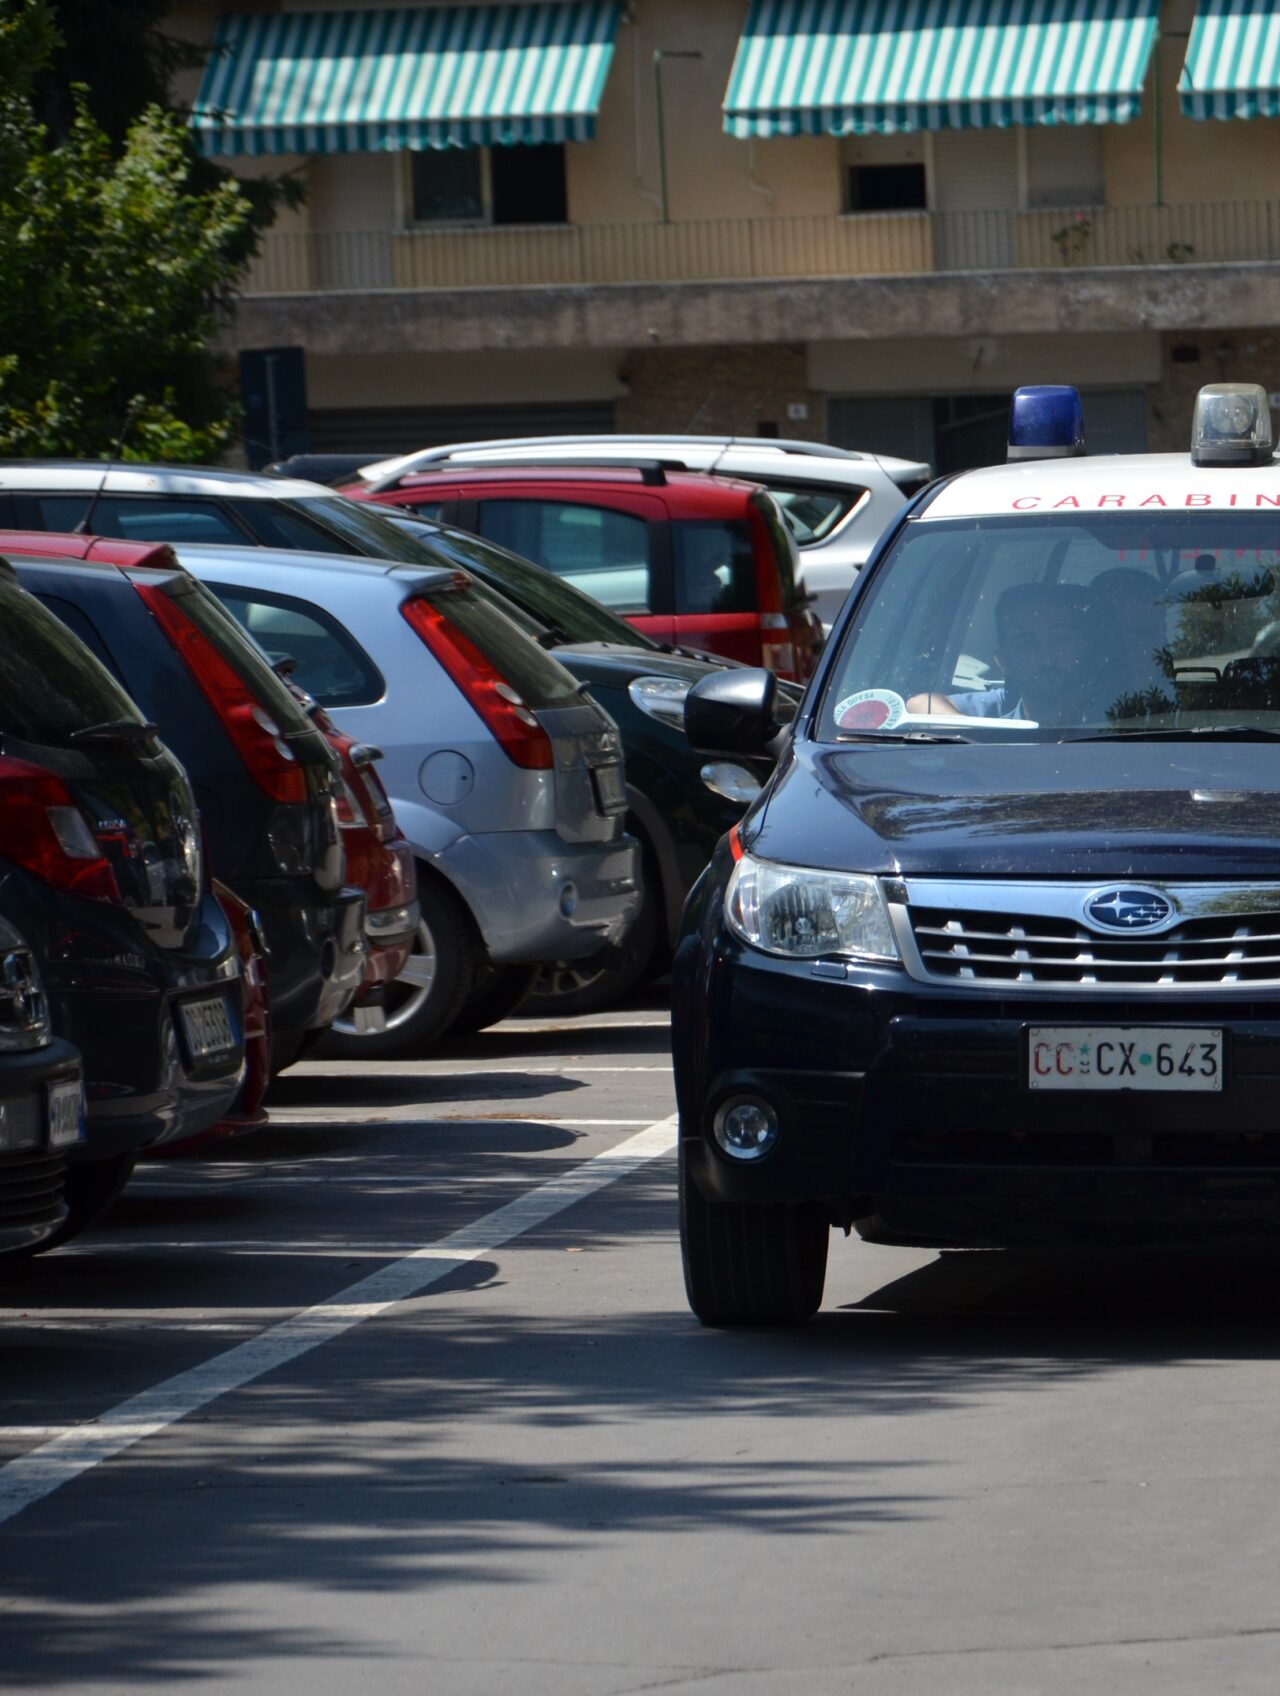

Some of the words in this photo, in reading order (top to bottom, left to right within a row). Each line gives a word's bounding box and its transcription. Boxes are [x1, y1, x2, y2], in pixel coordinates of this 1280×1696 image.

[1034, 1042, 1074, 1076] CC
[1096, 1042, 1137, 1076] CX
[1156, 1042, 1217, 1077] 643
